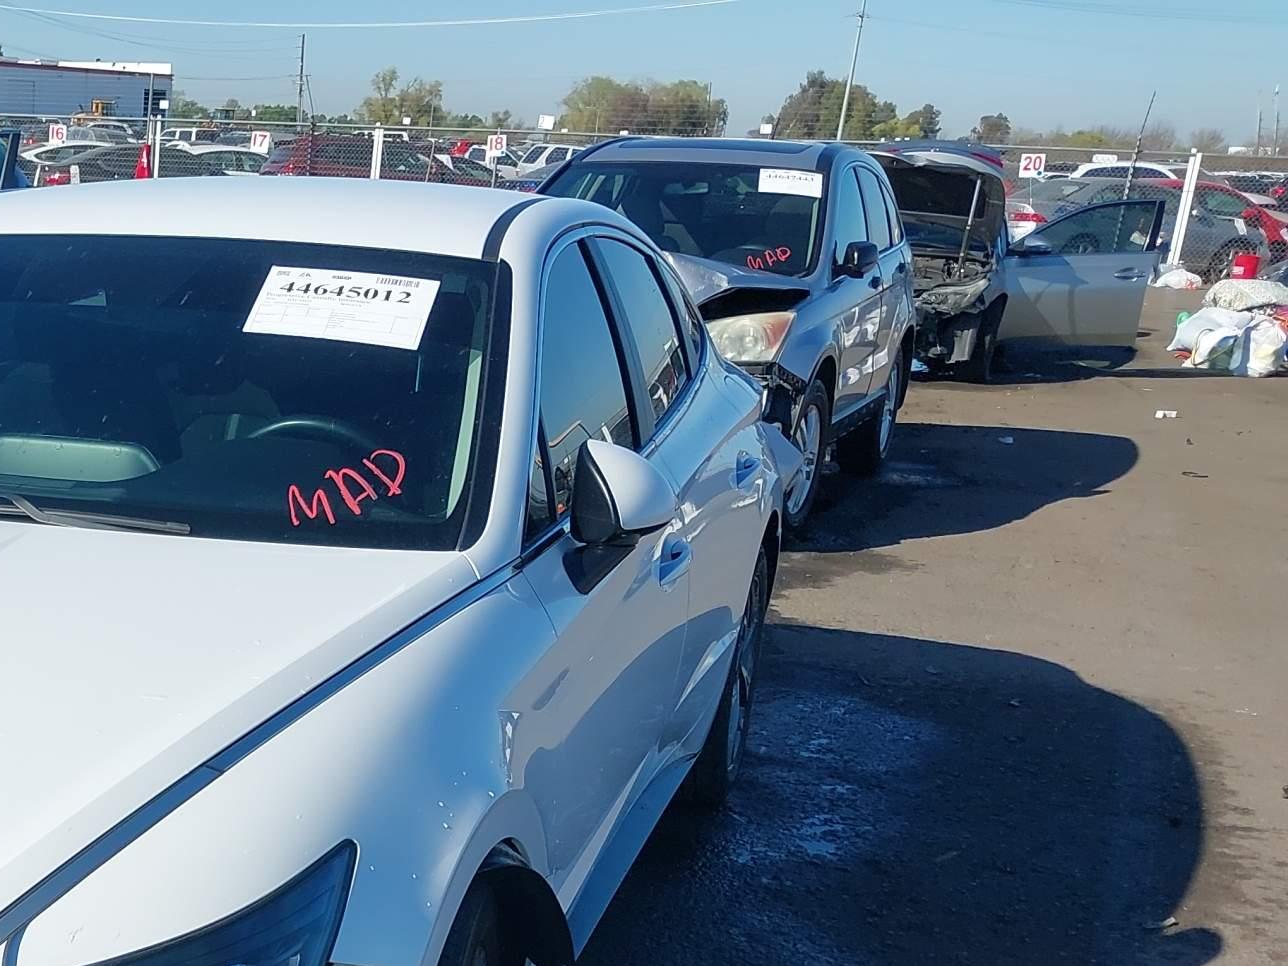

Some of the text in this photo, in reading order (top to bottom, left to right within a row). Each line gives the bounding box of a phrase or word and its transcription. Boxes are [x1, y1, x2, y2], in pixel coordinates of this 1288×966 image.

[50, 128, 65, 141] 16
[253, 134, 269, 148] 17
[489, 137, 504, 151] 18
[1022, 156, 1043, 171] 20
[747, 247, 792, 270] MAD
[279, 281, 413, 304] 44645012
[288, 448, 407, 526] MAD
